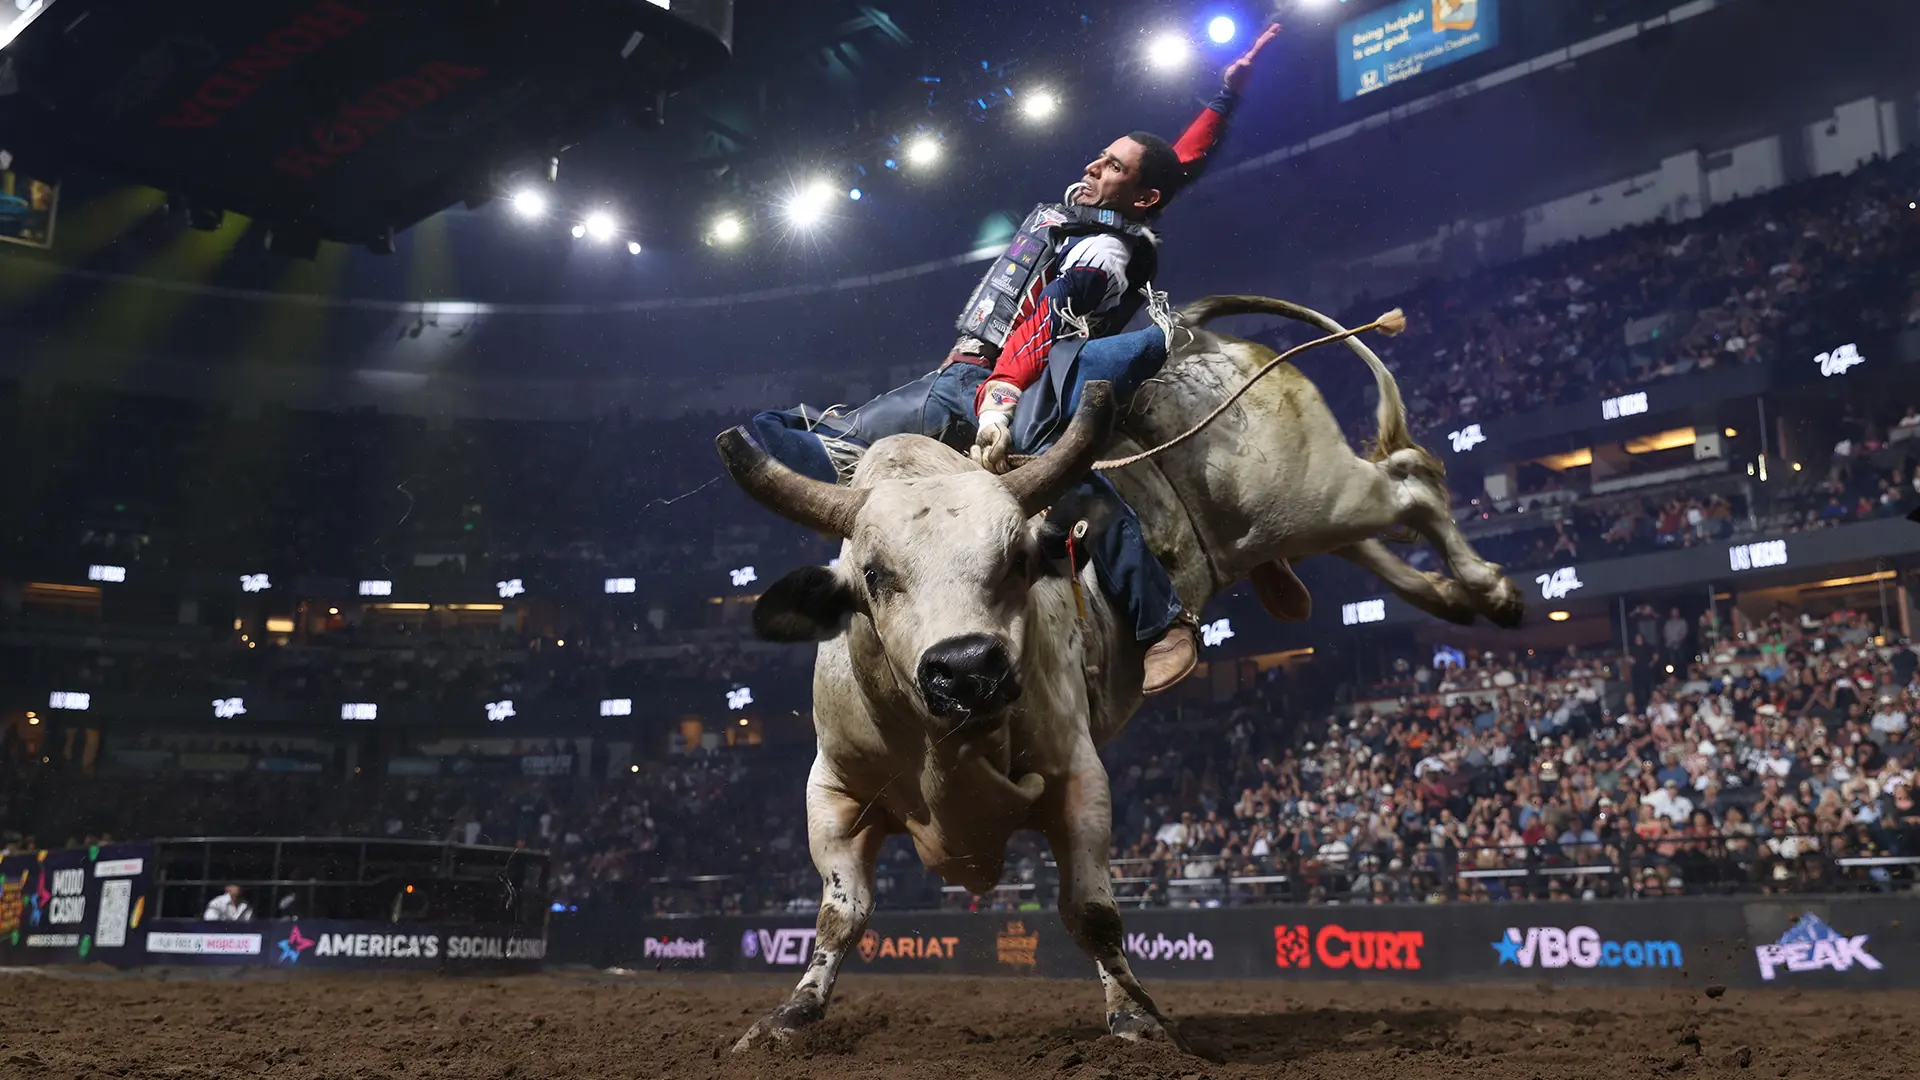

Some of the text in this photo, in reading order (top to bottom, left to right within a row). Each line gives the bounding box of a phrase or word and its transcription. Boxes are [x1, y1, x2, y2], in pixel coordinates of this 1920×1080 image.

[1385, 8, 1424, 33] helpful
[1353, 49, 1363, 60] is
[1364, 42, 1383, 57] our
[52, 868, 84, 895] MODO
[49, 895, 86, 924] CASINO
[314, 933, 439, 957] AMERICA'S
[447, 935, 503, 958] SOCIAL
[644, 936, 705, 958] Priefert
[879, 937, 959, 958] ARIAT
[1127, 932, 1214, 961] Kubota
[1315, 924, 1424, 969] CURT
[1755, 934, 1884, 980] PEAK
